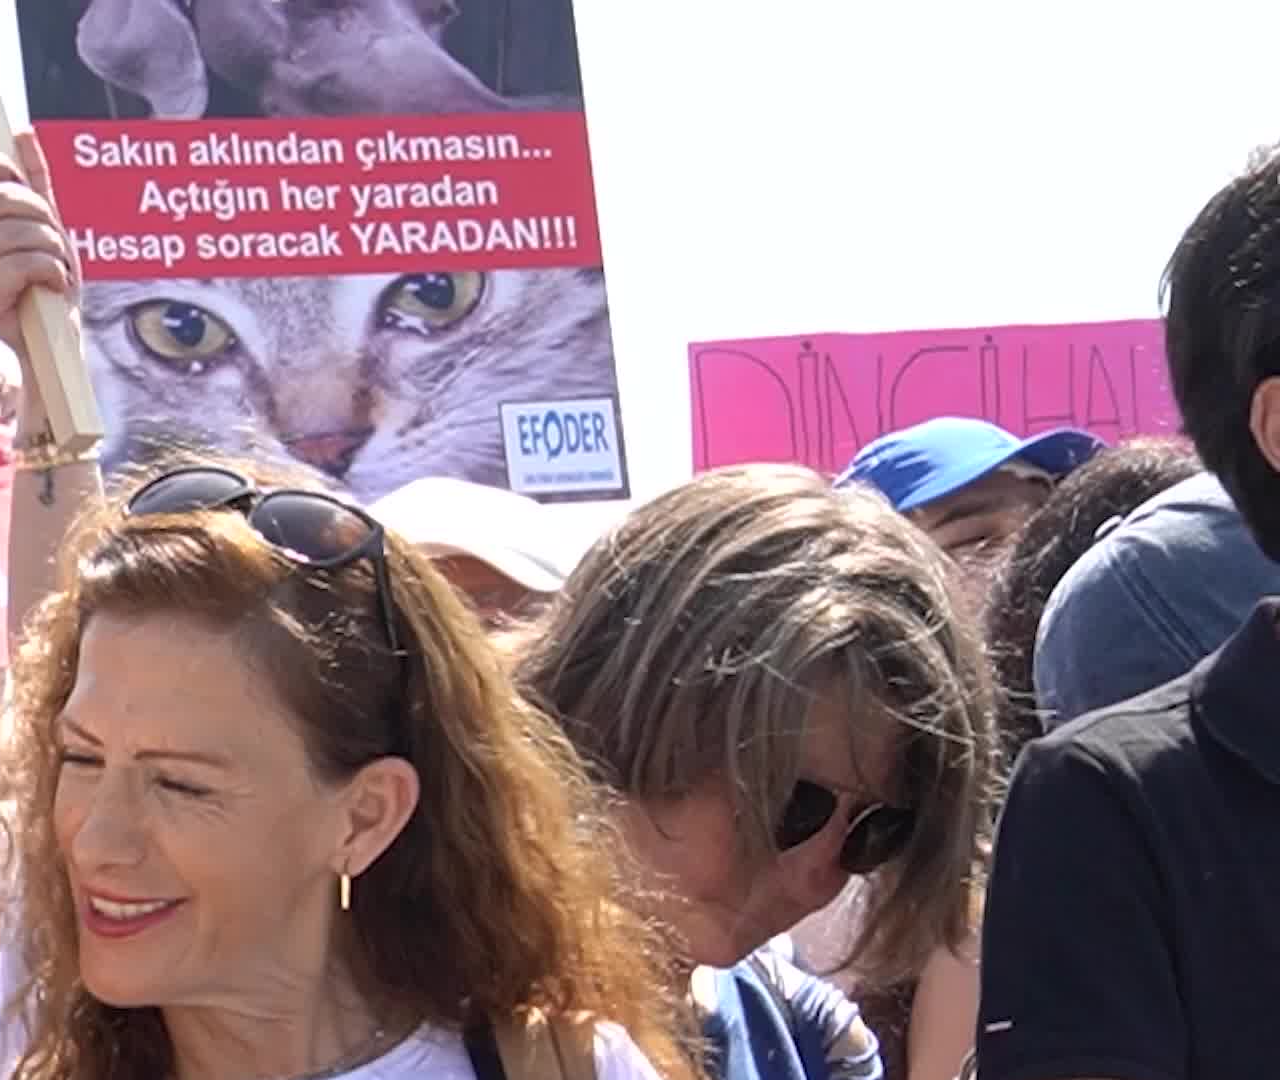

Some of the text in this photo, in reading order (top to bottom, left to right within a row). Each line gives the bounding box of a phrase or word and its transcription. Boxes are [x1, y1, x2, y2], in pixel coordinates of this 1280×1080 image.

[73, 130, 552, 171] Sakın aklından çıkmasın...
[139, 174, 498, 222] Açtığın her yaradan
[71, 215, 578, 267] Hesap soracak YARADAN!!!
[517, 410, 609, 461] EFODER
